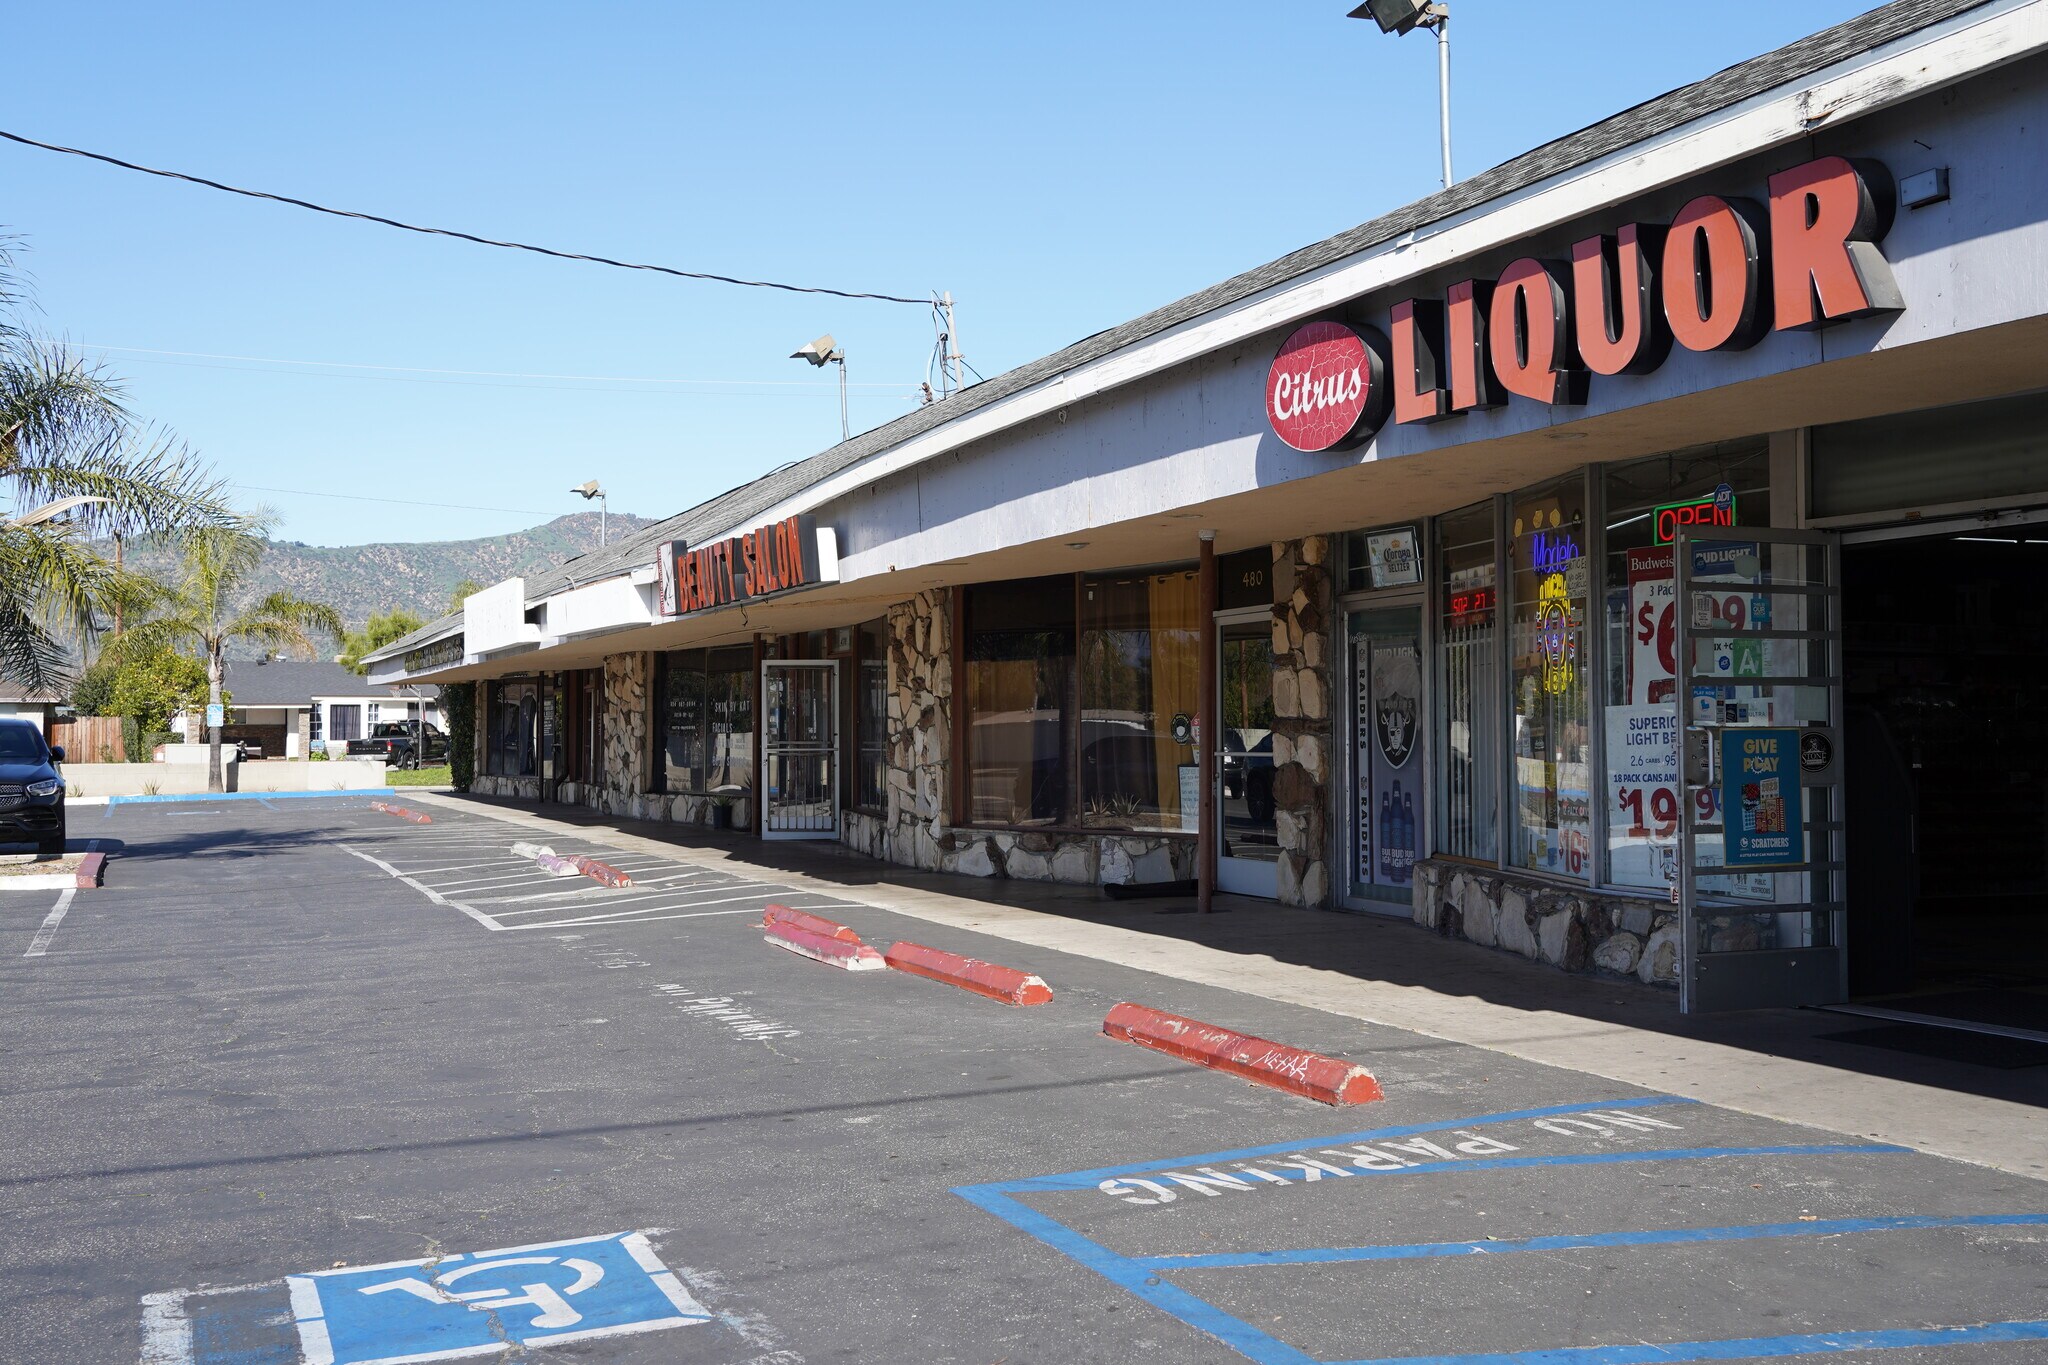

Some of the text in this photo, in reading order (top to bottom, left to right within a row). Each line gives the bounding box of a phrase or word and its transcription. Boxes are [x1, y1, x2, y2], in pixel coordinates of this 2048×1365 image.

[1391, 156, 1878, 425] LIQUOR
[1274, 366, 1362, 421] Citrus
[1716, 490, 1731, 502] ADT
[1384, 547, 1412, 562] Corona
[1533, 532, 1579, 574] Modelo
[678, 537, 736, 613] BEAUTY
[742, 516, 804, 597] SALON
[1388, 562, 1411, 573] SELTZER
[1631, 557, 1674, 571] Budweis
[1242, 570, 1263, 587] 480
[1650, 585, 1654, 596] 3
[1738, 648, 1757, 675] A
[715, 702, 728, 713] SKIN
[739, 700, 750, 712] KAT
[1359, 669, 1367, 750] RAIDERS
[712, 722, 733, 733] FACIALS
[1629, 716, 1676, 730] SUPERI
[1626, 732, 1659, 746] LIGHT
[1743, 739, 1778, 754] GIVE
[1630, 755, 1644, 767] 2.6
[1743, 757, 1780, 773] PLAY
[1802, 752, 1827, 765] STONE
[1614, 774, 1622, 783] 18
[1623, 774, 1641, 783] PACK
[1642, 773, 1663, 782] CANS
[1751, 837, 1790, 849] SCRATCHERS
[1099, 1108, 1684, 1206] NO PARKING
